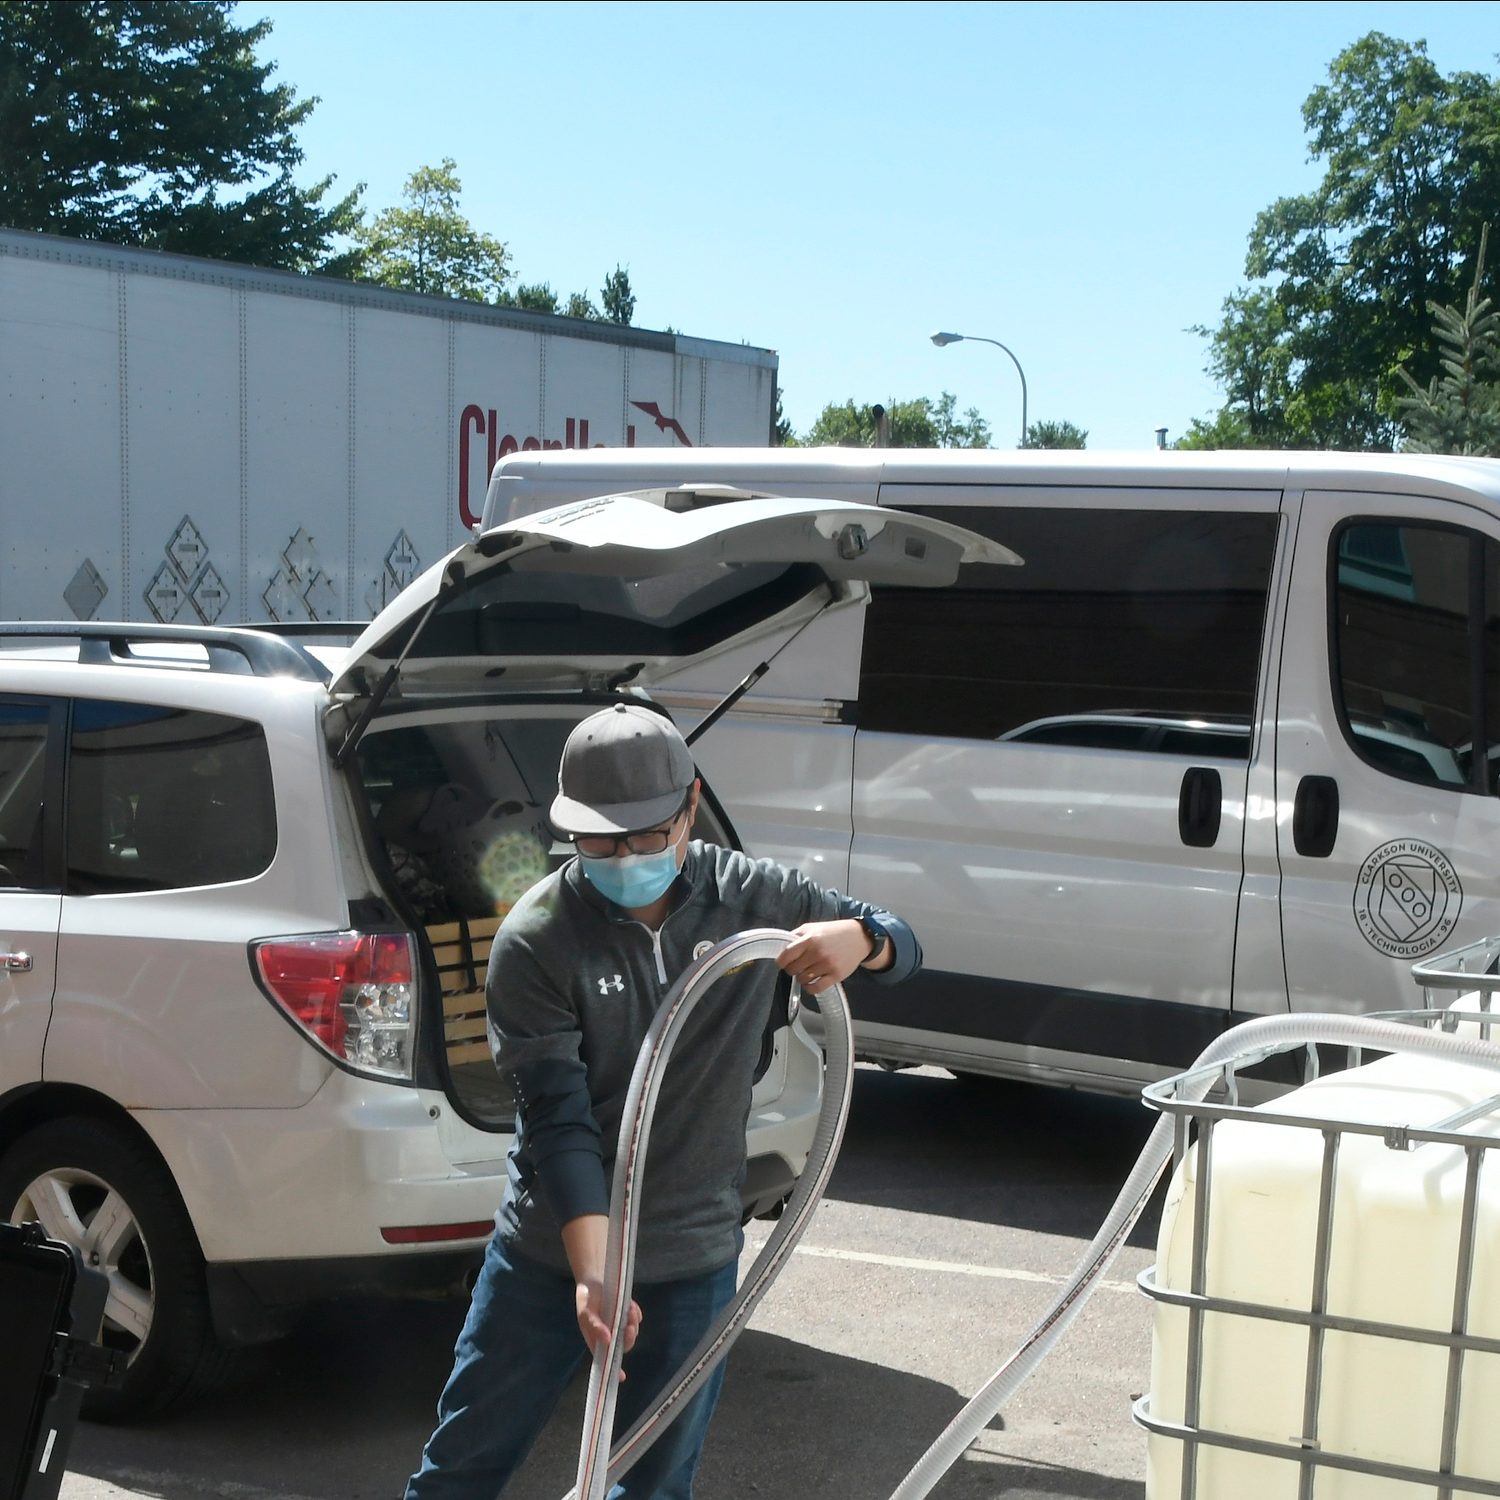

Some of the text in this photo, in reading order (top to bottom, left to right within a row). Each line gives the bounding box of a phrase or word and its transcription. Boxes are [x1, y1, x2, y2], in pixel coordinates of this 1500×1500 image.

[1361, 843, 1459, 894] CLARKSON UNIVERSITY
[1366, 928, 1437, 955] TECHNOLOGIA
[1440, 918, 1452, 932] 96
